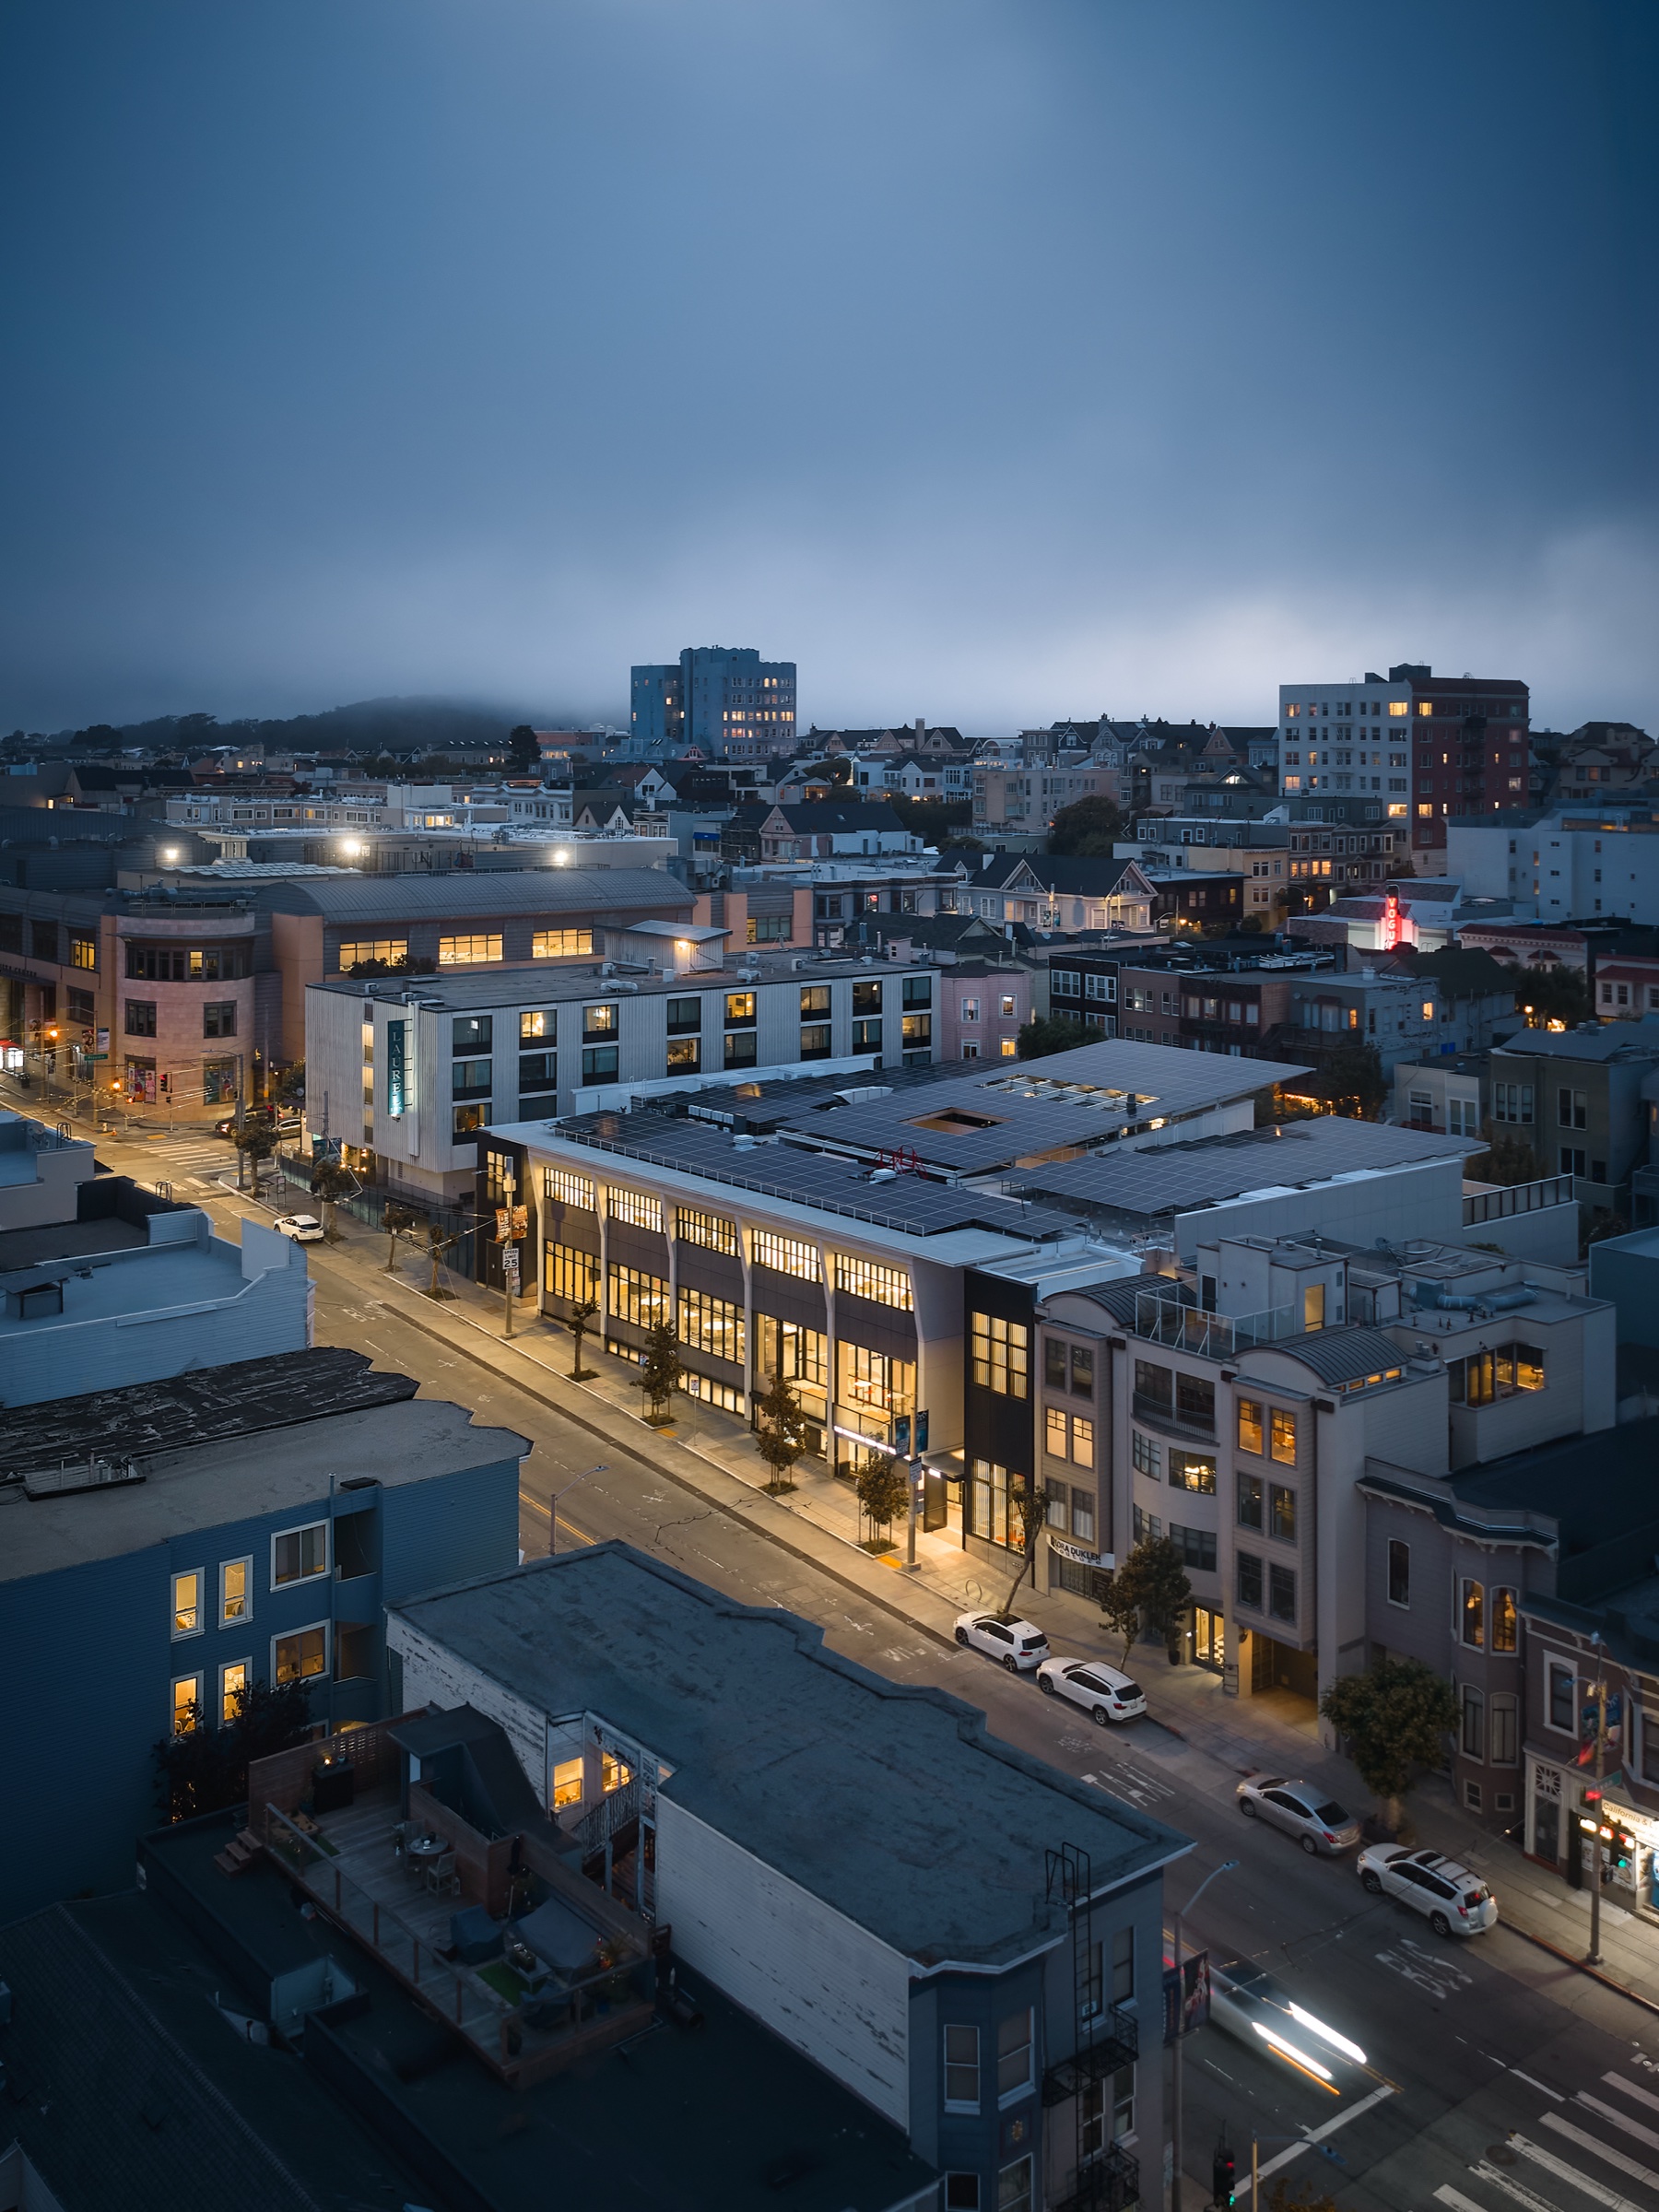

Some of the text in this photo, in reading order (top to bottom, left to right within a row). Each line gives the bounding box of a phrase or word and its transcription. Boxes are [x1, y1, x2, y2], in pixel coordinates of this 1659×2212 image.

[392, 1031, 402, 1106] LAUREL
[504, 1259, 518, 1268] 25
[1603, 1802, 1641, 1823] California
